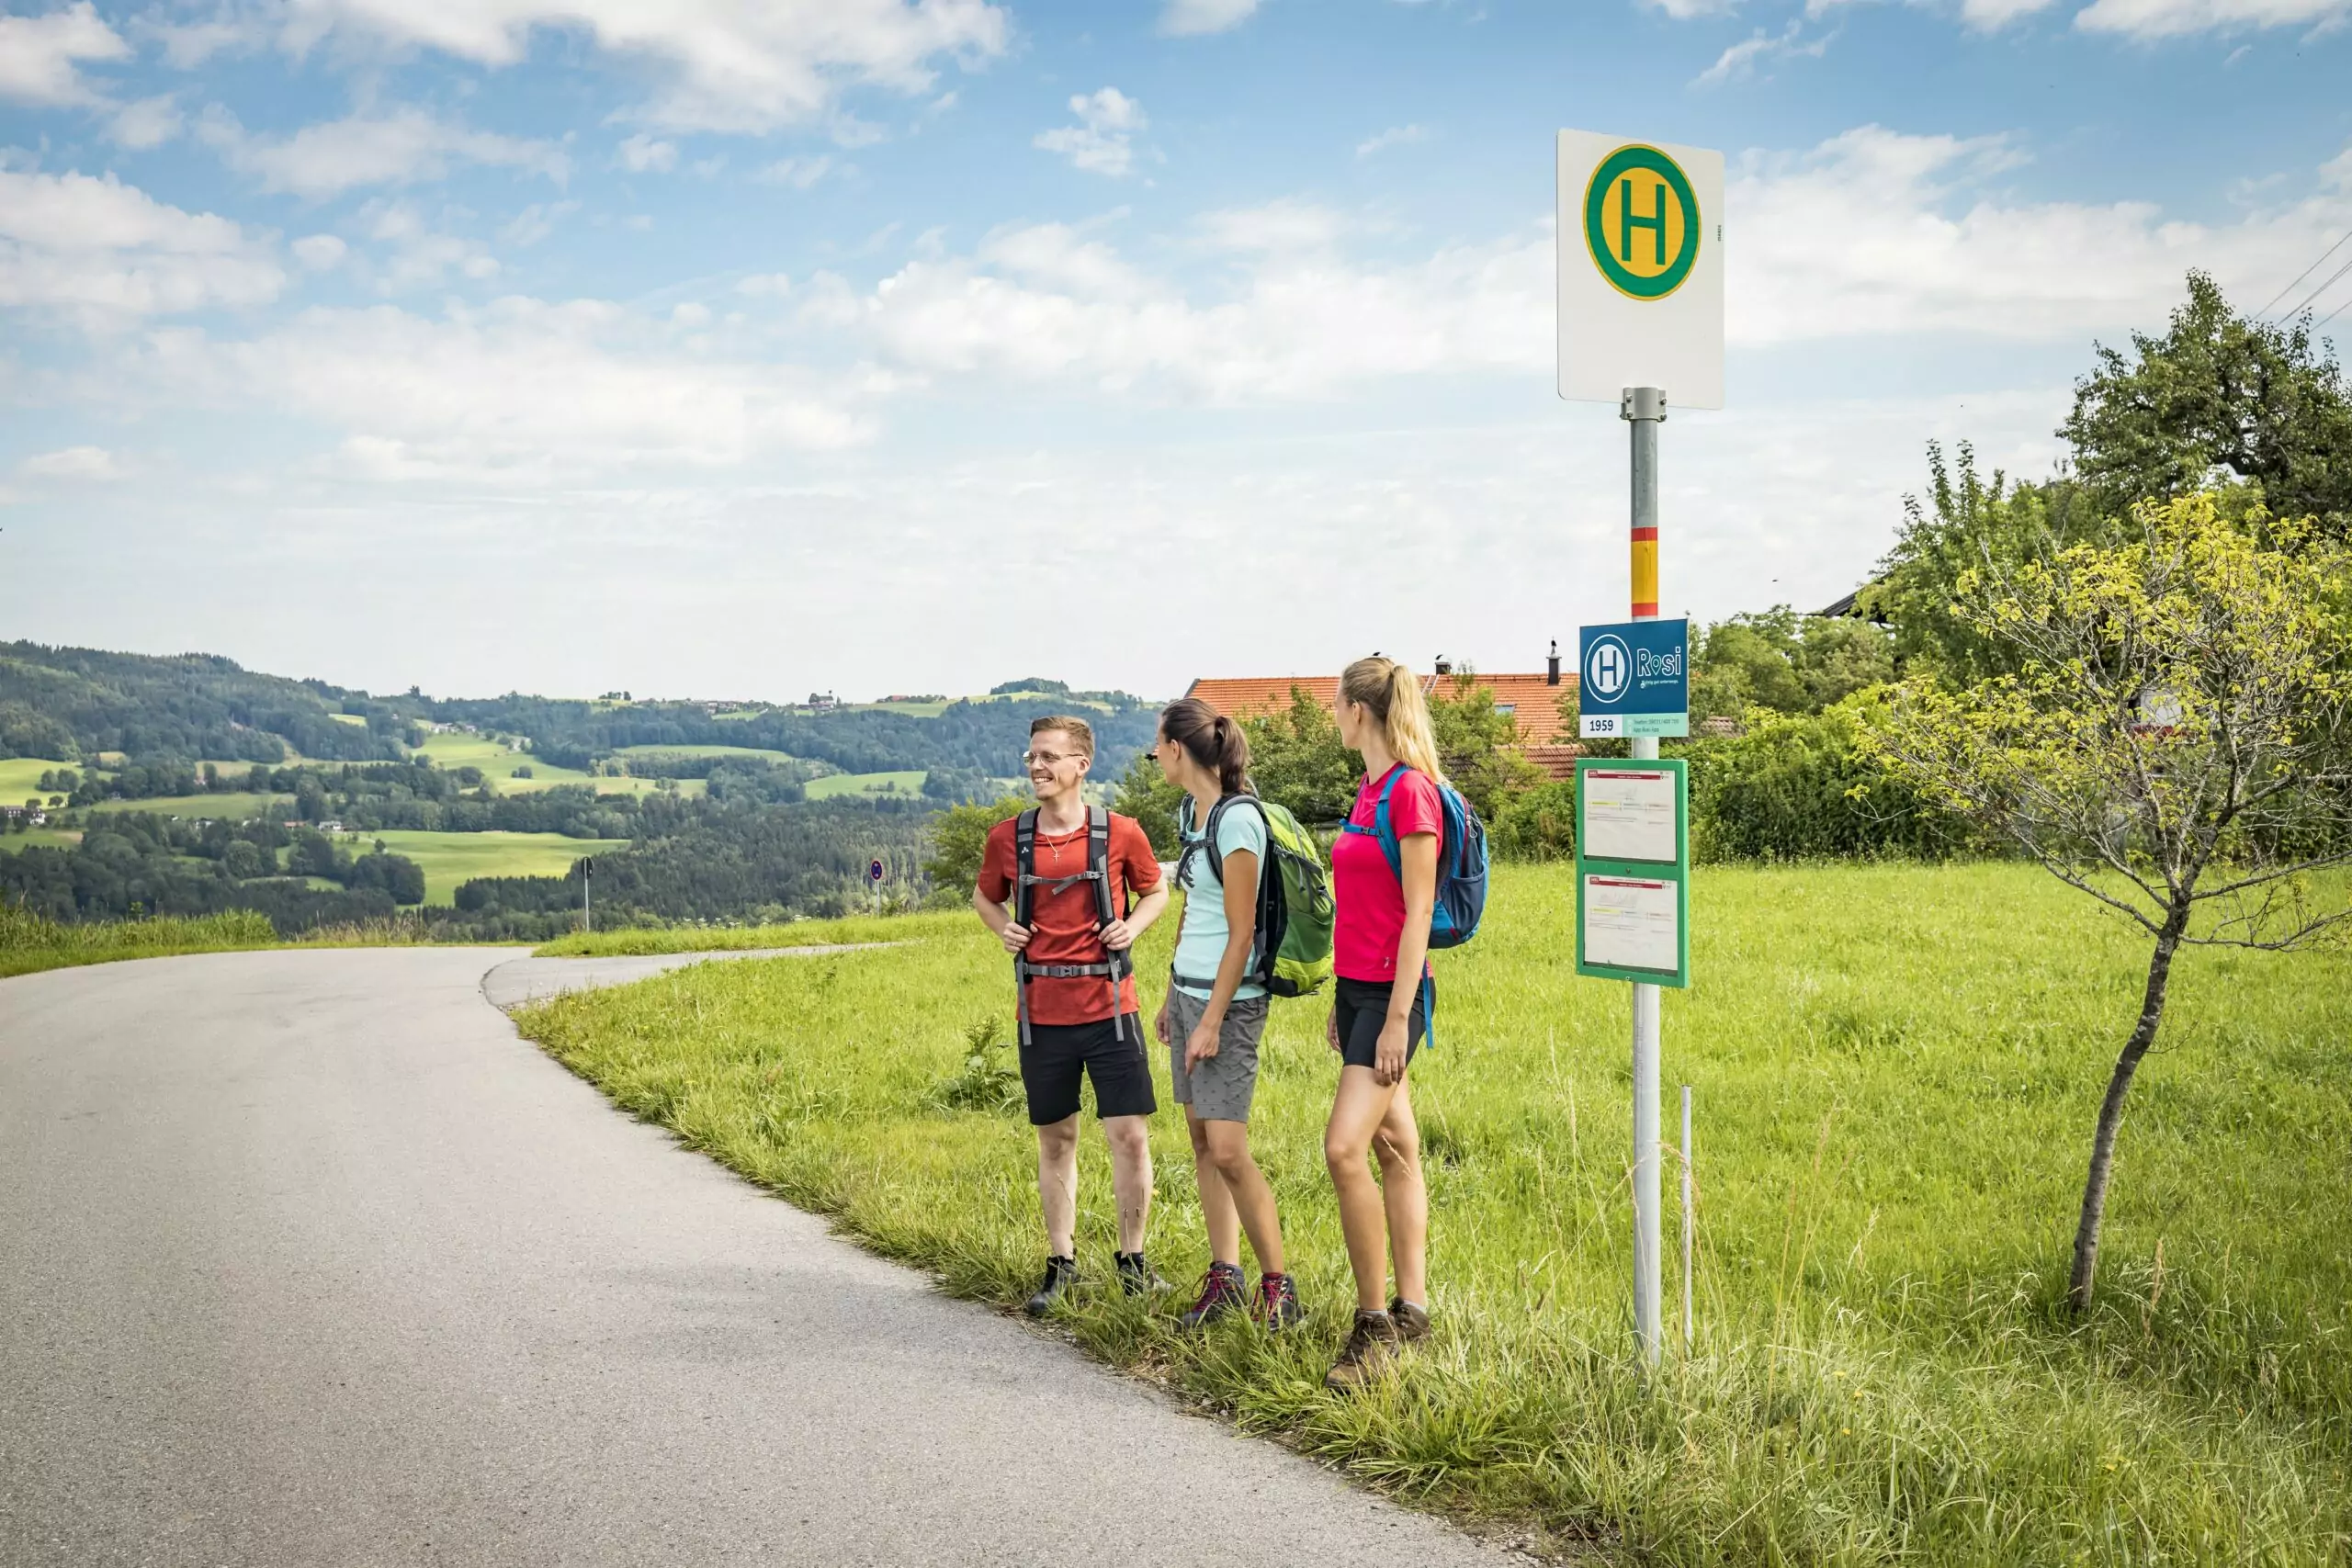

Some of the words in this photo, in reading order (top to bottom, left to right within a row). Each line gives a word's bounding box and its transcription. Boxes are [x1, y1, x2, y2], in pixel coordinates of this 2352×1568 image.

[1622, 179, 1666, 265] H
[1600, 650, 1617, 687] H
[1637, 647, 1681, 677] Rosi
[1589, 719, 1613, 732] 1959
